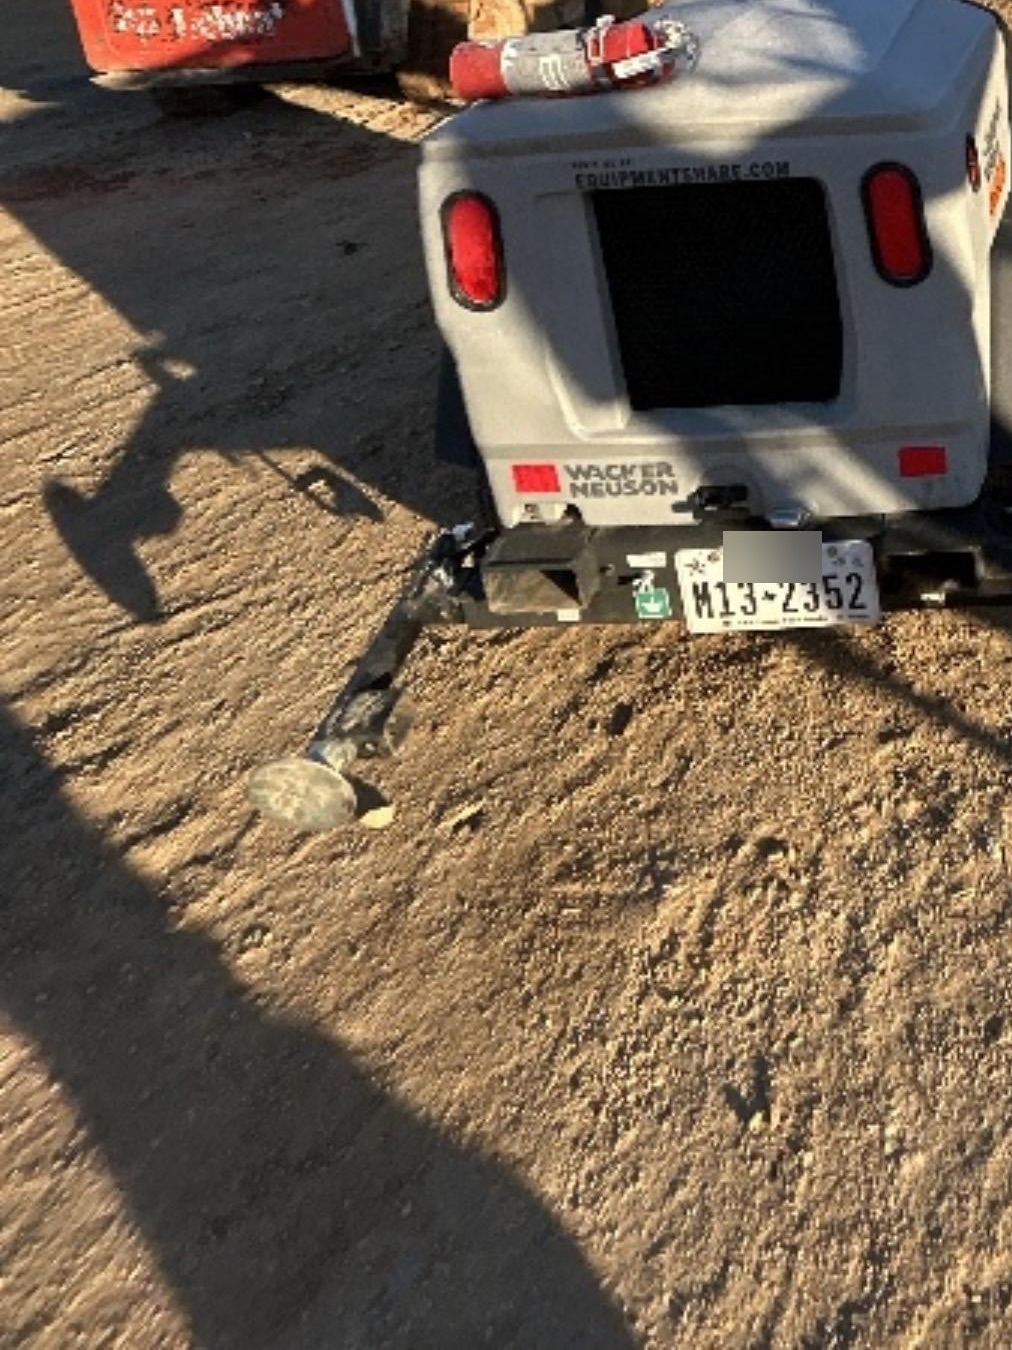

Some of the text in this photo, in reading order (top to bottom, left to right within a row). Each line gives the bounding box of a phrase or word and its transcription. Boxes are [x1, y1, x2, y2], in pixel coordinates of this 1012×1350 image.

[575, 160, 791, 189] EQUIPMENTSHARE.COM
[564, 461, 675, 481] WACKER
[569, 479, 679, 498] NEUSON
